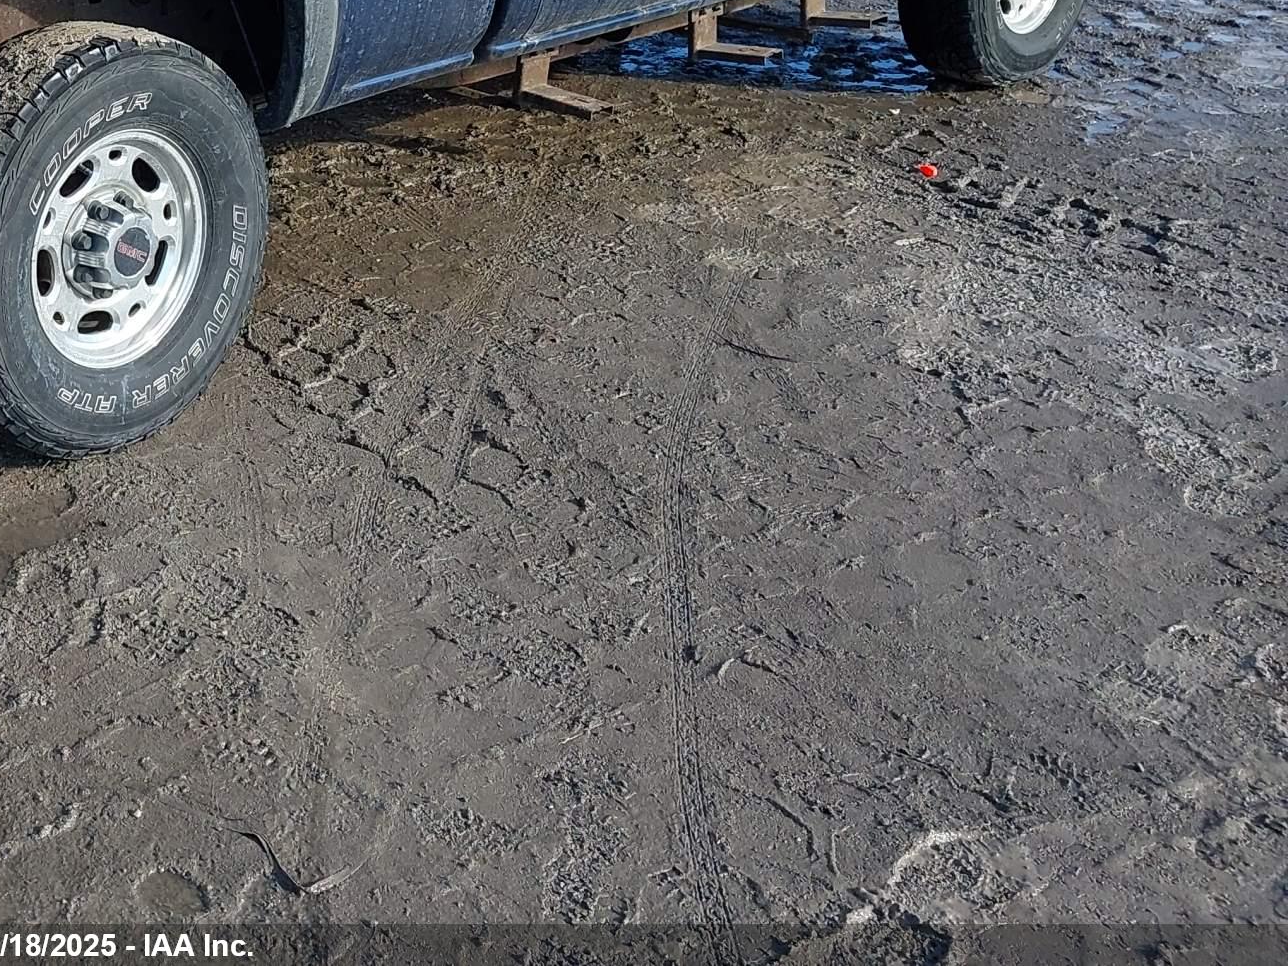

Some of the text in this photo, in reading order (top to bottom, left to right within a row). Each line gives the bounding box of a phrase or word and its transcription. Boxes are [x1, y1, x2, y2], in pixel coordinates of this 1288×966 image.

[29, 93, 152, 215] COOPER
[57, 205, 248, 413] DISCOVERER ATP
[117, 241, 148, 263] GMC
